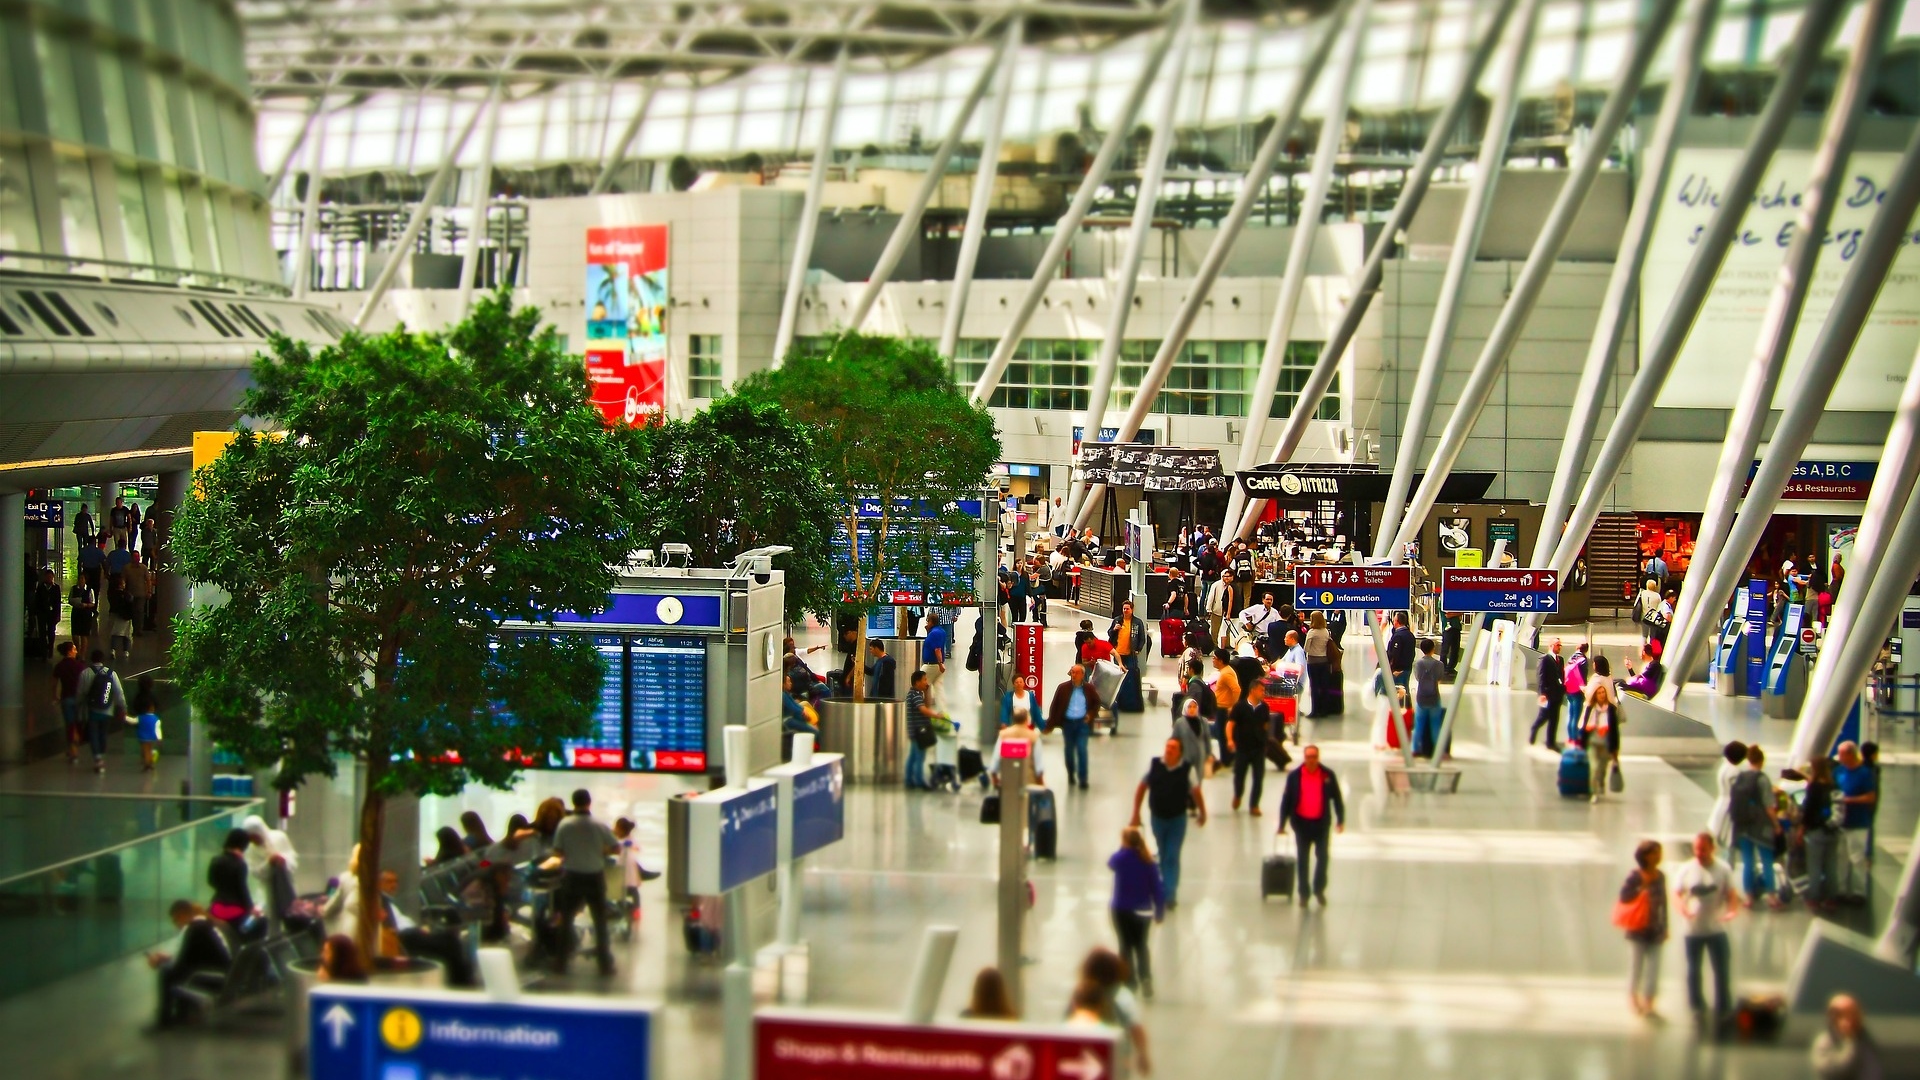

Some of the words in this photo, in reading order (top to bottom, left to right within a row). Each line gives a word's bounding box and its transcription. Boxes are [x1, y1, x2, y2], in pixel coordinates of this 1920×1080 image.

[1886, 373, 1909, 382] Erdga
[1792, 466, 1807, 475] es
[1246, 476, 1280, 490] Caffè
[1300, 477, 1338, 493] RITAZZA
[1804, 484, 1856, 493] Restaurants
[1450, 575, 1471, 583] Shops
[1478, 575, 1517, 583] Restaurants
[1336, 594, 1380, 602] Information
[1488, 600, 1517, 608] Customs
[1028, 626, 1036, 673] SAFER
[429, 1020, 560, 1047] Information
[772, 1037, 838, 1064] Shops
[862, 1043, 984, 1072] Restaurants
